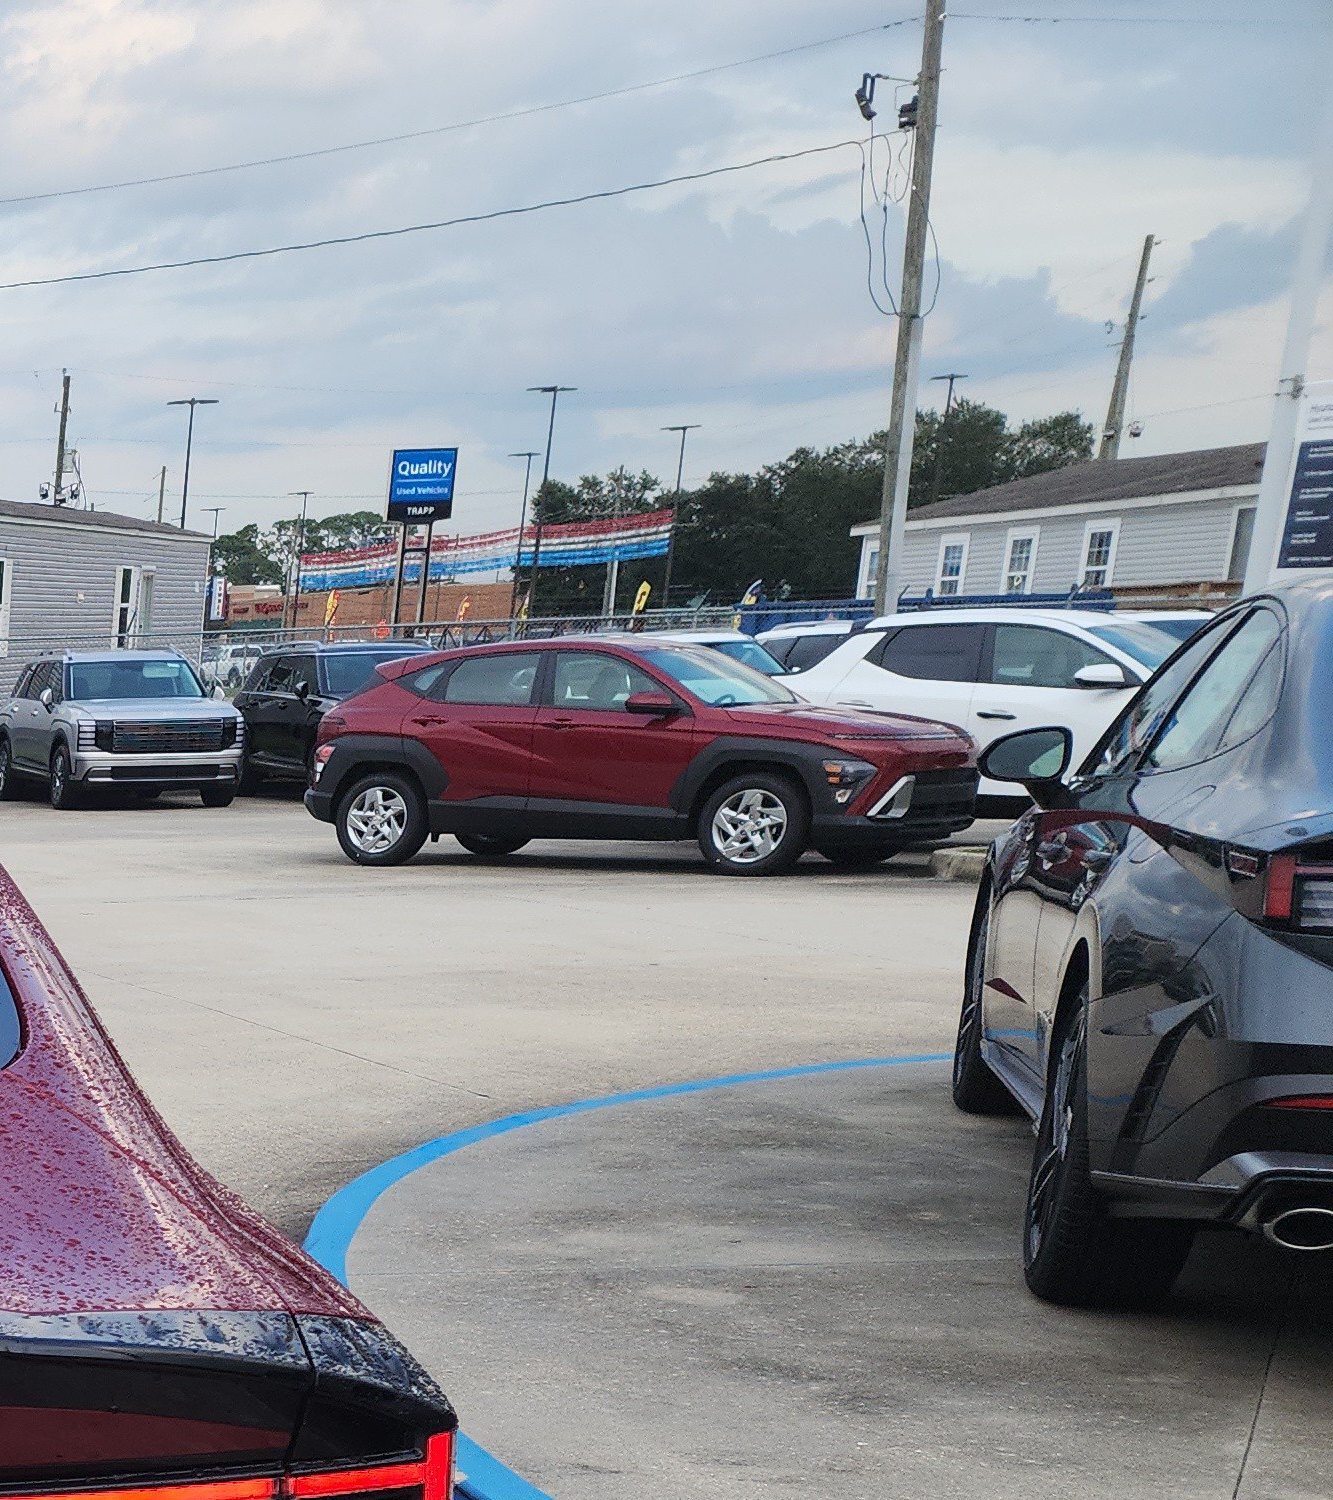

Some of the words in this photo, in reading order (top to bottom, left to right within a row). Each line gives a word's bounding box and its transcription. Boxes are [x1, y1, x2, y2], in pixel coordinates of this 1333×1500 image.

[398, 459, 452, 477] Quality
[396, 486, 415, 495] Used
[417, 485, 448, 495] Vehicles
[407, 506, 435, 515] TRAPP
